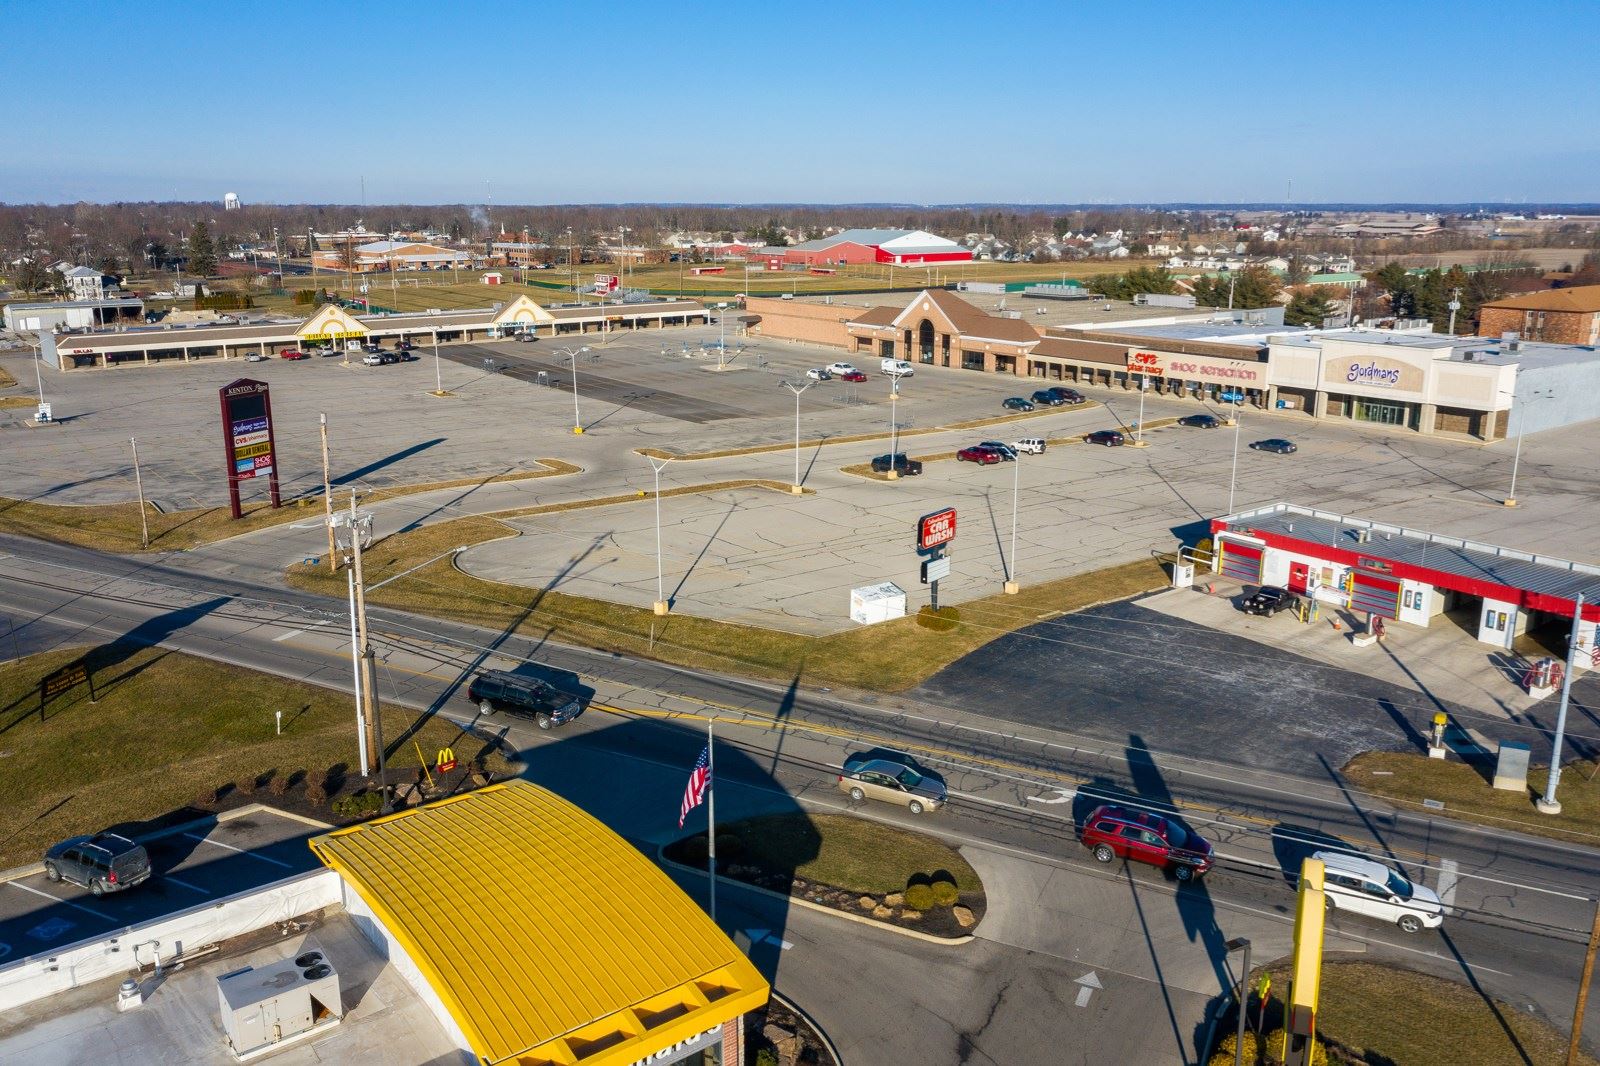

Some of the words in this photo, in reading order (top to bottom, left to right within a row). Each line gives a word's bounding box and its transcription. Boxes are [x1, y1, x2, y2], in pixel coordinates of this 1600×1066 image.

[1135, 352, 1159, 365] CVS
[1347, 362, 1399, 383] gordmans
[228, 385, 253, 395] KENTON
[236, 448, 251, 458] DOLLAR
[252, 444, 269, 454] GENERAL
[930, 518, 949, 533] CAR
[926, 527, 953, 546] WASH
